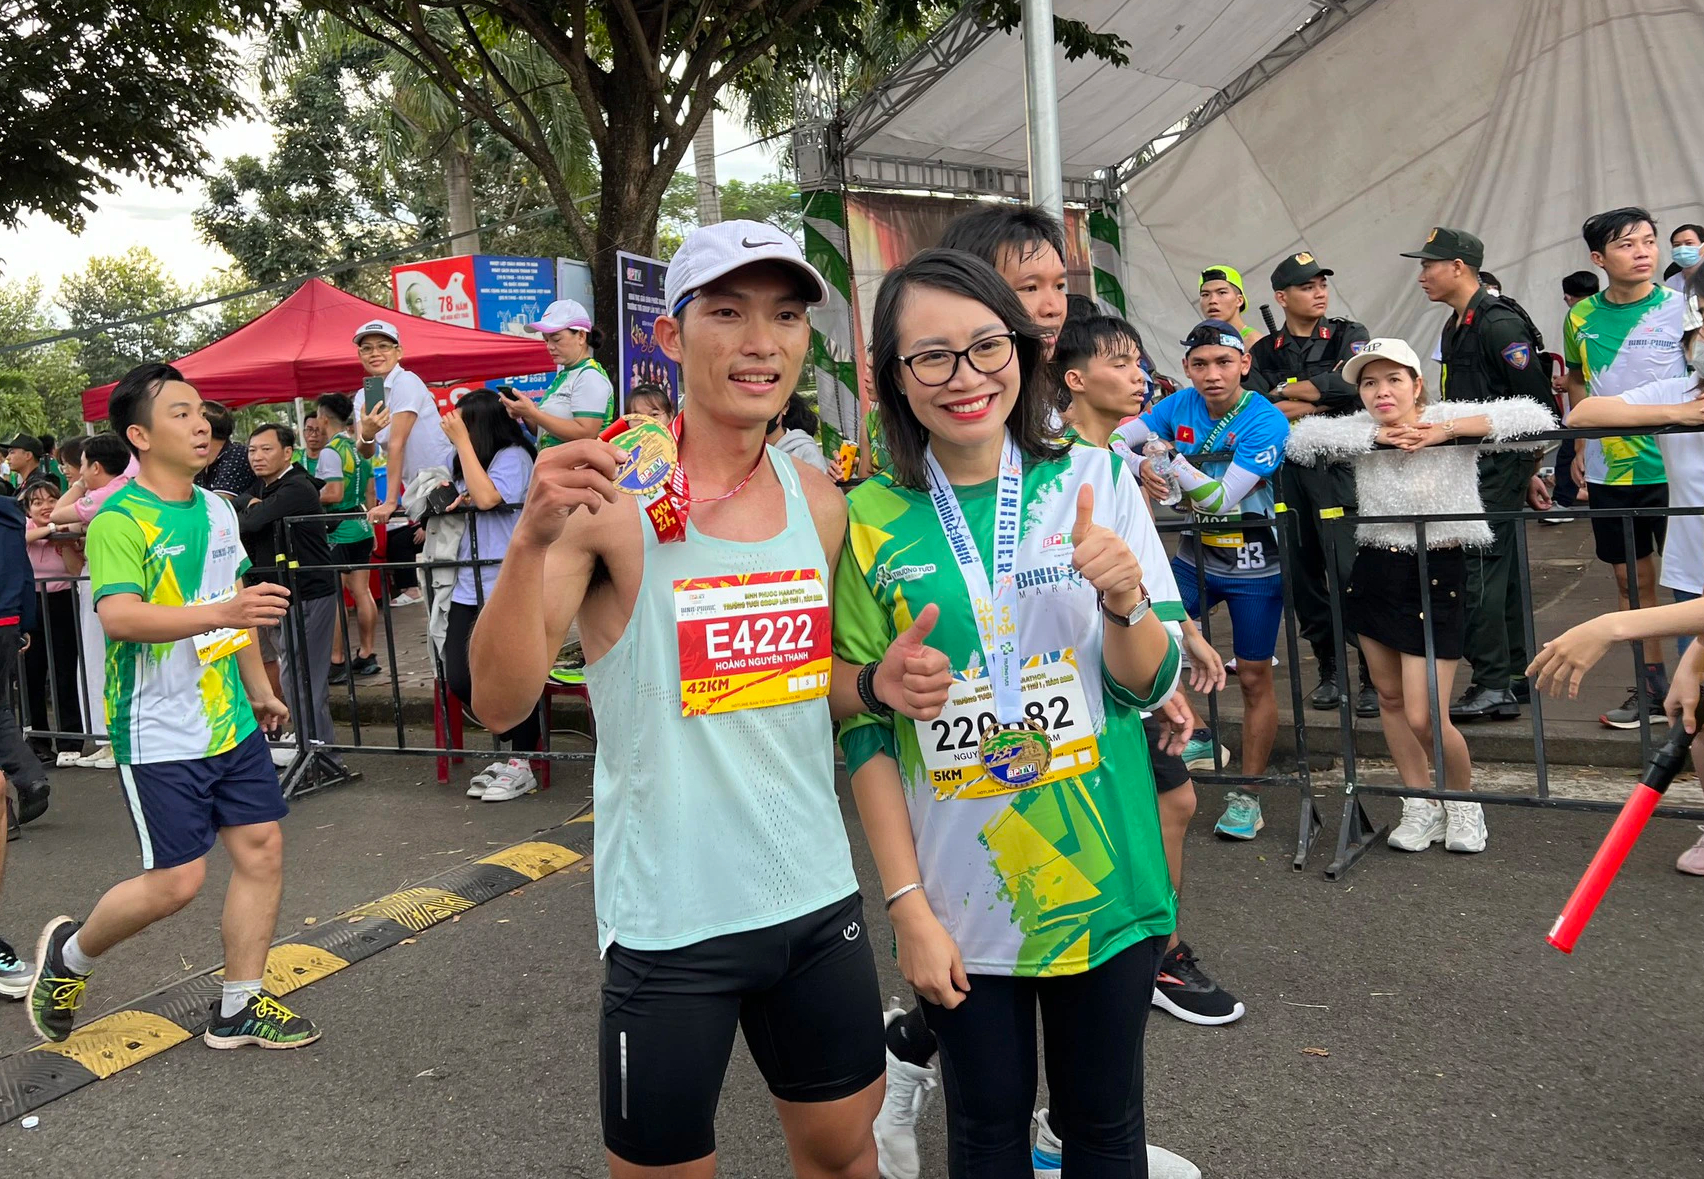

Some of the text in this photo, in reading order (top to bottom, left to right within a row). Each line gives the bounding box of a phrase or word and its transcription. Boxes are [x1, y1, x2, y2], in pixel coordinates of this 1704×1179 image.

[438, 295, 453, 312] 78
[1203, 412, 1233, 451] FINISHER
[640, 457, 665, 481] BPTV
[651, 500, 671, 520] KM
[656, 515, 676, 531] 42
[997, 475, 1018, 574] FINISHER
[1042, 533, 1072, 548] BPT
[1237, 542, 1266, 569] 93
[1001, 605, 1010, 623] 5
[706, 614, 813, 659] E4222
[997, 623, 1016, 636] KM
[715, 658, 746, 671] HOÀNG
[784, 651, 809, 662] THANH
[686, 677, 730, 695] 42KM
[931, 696, 1074, 752] 22082
[953, 750, 980, 761] NGUY
[934, 769, 962, 781] 5KM
[1007, 763, 1035, 778] BPTV
